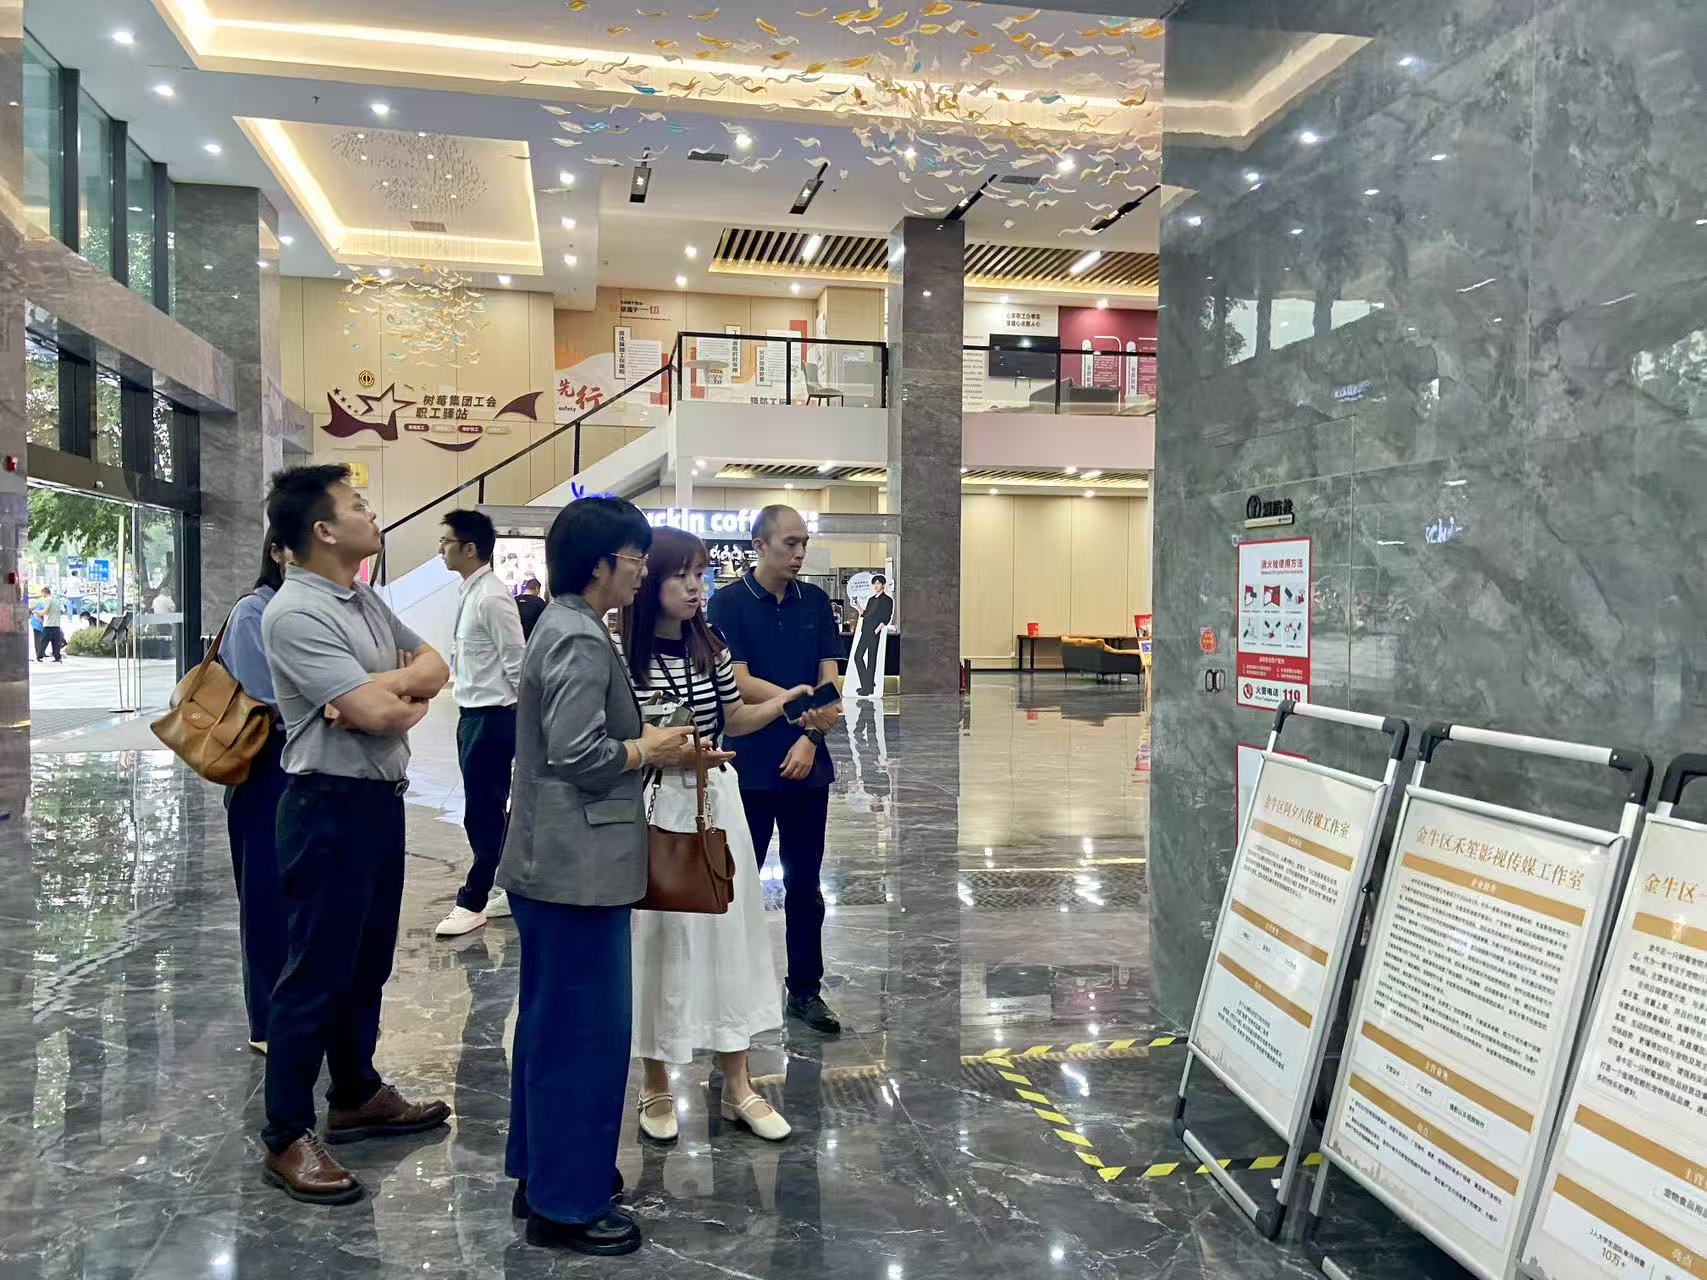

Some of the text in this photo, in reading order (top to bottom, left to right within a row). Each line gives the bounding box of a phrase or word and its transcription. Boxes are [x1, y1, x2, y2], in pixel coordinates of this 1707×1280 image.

[423, 394, 498, 409] 树莓集团工会
[557, 378, 604, 410] 先行
[415, 407, 469, 420] 职工驿站
[558, 405, 577, 413] safety
[646, 507, 760, 533] ckin coff
[1261, 559, 1303, 569] 消火栓使用方法
[1255, 686, 1279, 697] 火警电话
[1416, 824, 1585, 891] 金牛区禾笙影视传媒工作室
[1601, 1247, 1627, 1269] 10万+
